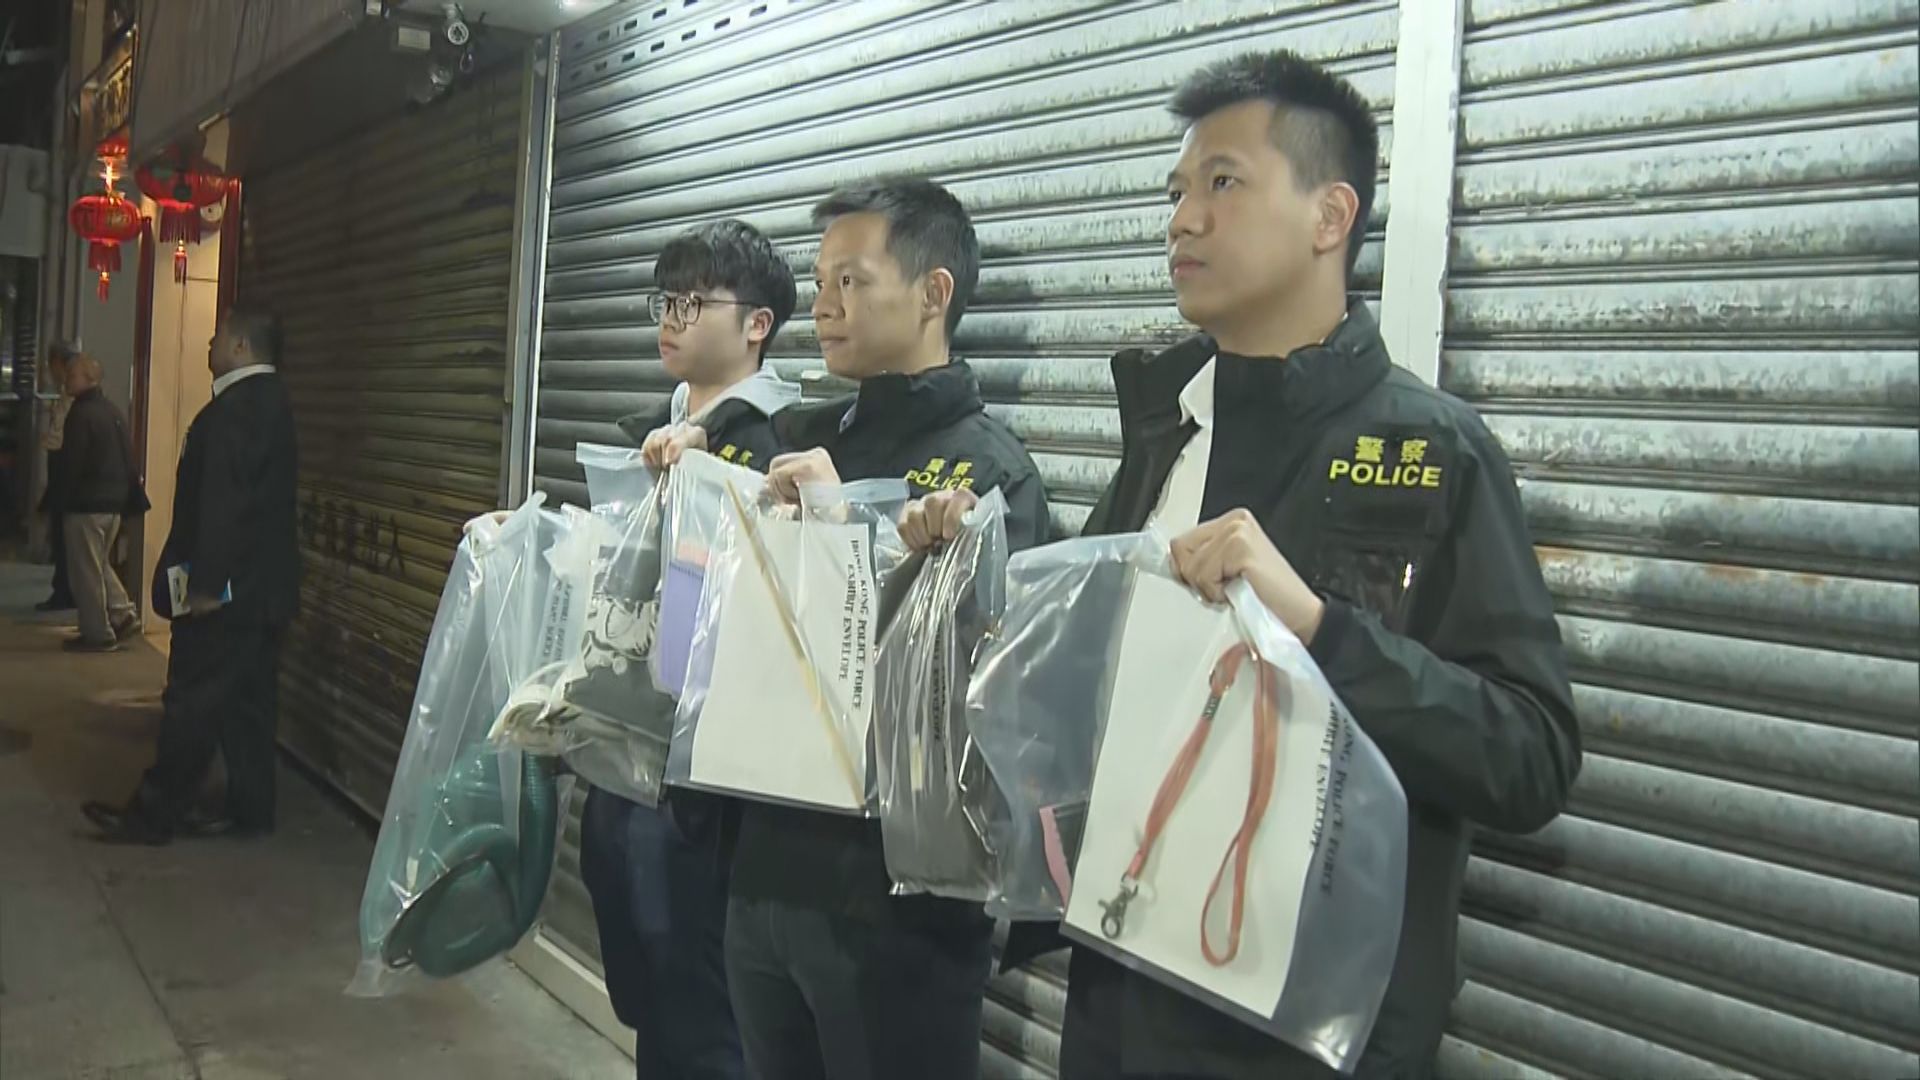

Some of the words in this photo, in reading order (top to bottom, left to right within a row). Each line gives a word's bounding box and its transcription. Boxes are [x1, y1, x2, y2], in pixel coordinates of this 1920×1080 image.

[1355, 436, 1427, 463] 警察
[904, 469, 974, 491] POLICE
[1329, 459, 1441, 487] POLICE
[844, 563, 857, 613] EXHIBIT
[859, 579, 869, 615] KONG
[839, 617, 853, 682] ENVELOPE
[855, 619, 868, 665] POLICE
[851, 669, 864, 711] FORCE
[1332, 769, 1348, 832] POLICE
[1320, 837, 1341, 896] FORCE
